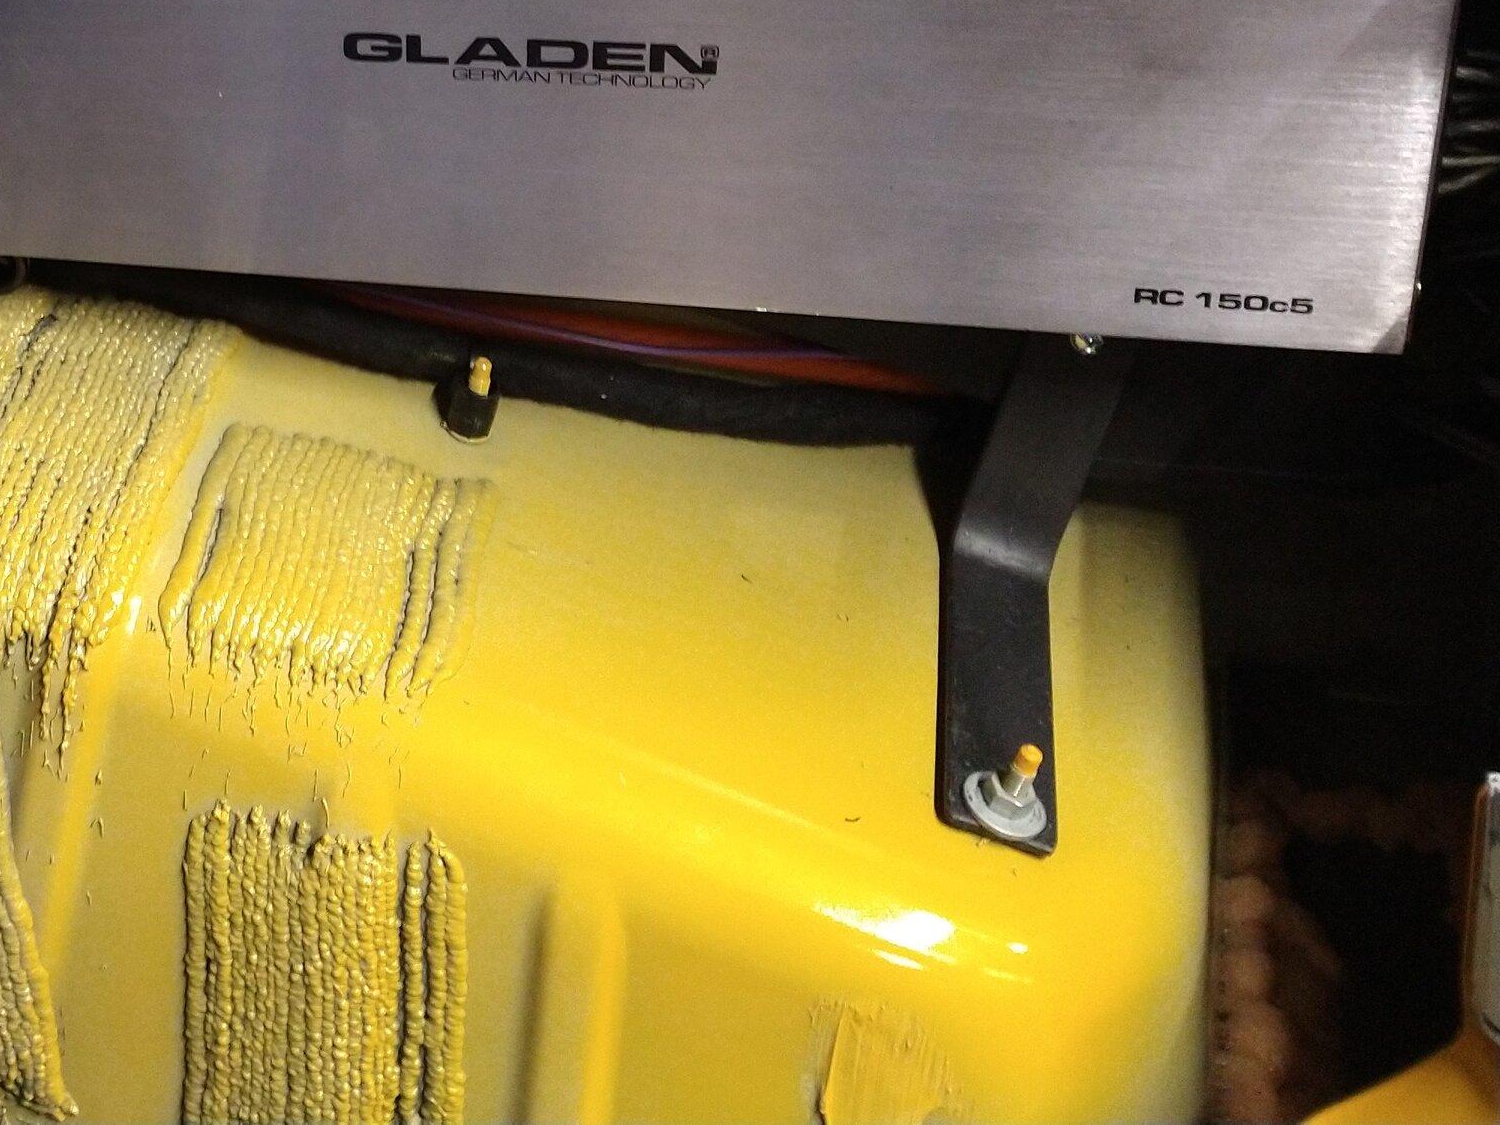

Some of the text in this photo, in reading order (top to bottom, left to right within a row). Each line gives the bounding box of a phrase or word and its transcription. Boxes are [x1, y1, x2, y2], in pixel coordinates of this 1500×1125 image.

[452, 66, 711, 91] GERMAN TECHNOLOGY
[1133, 287, 1184, 306] RC
